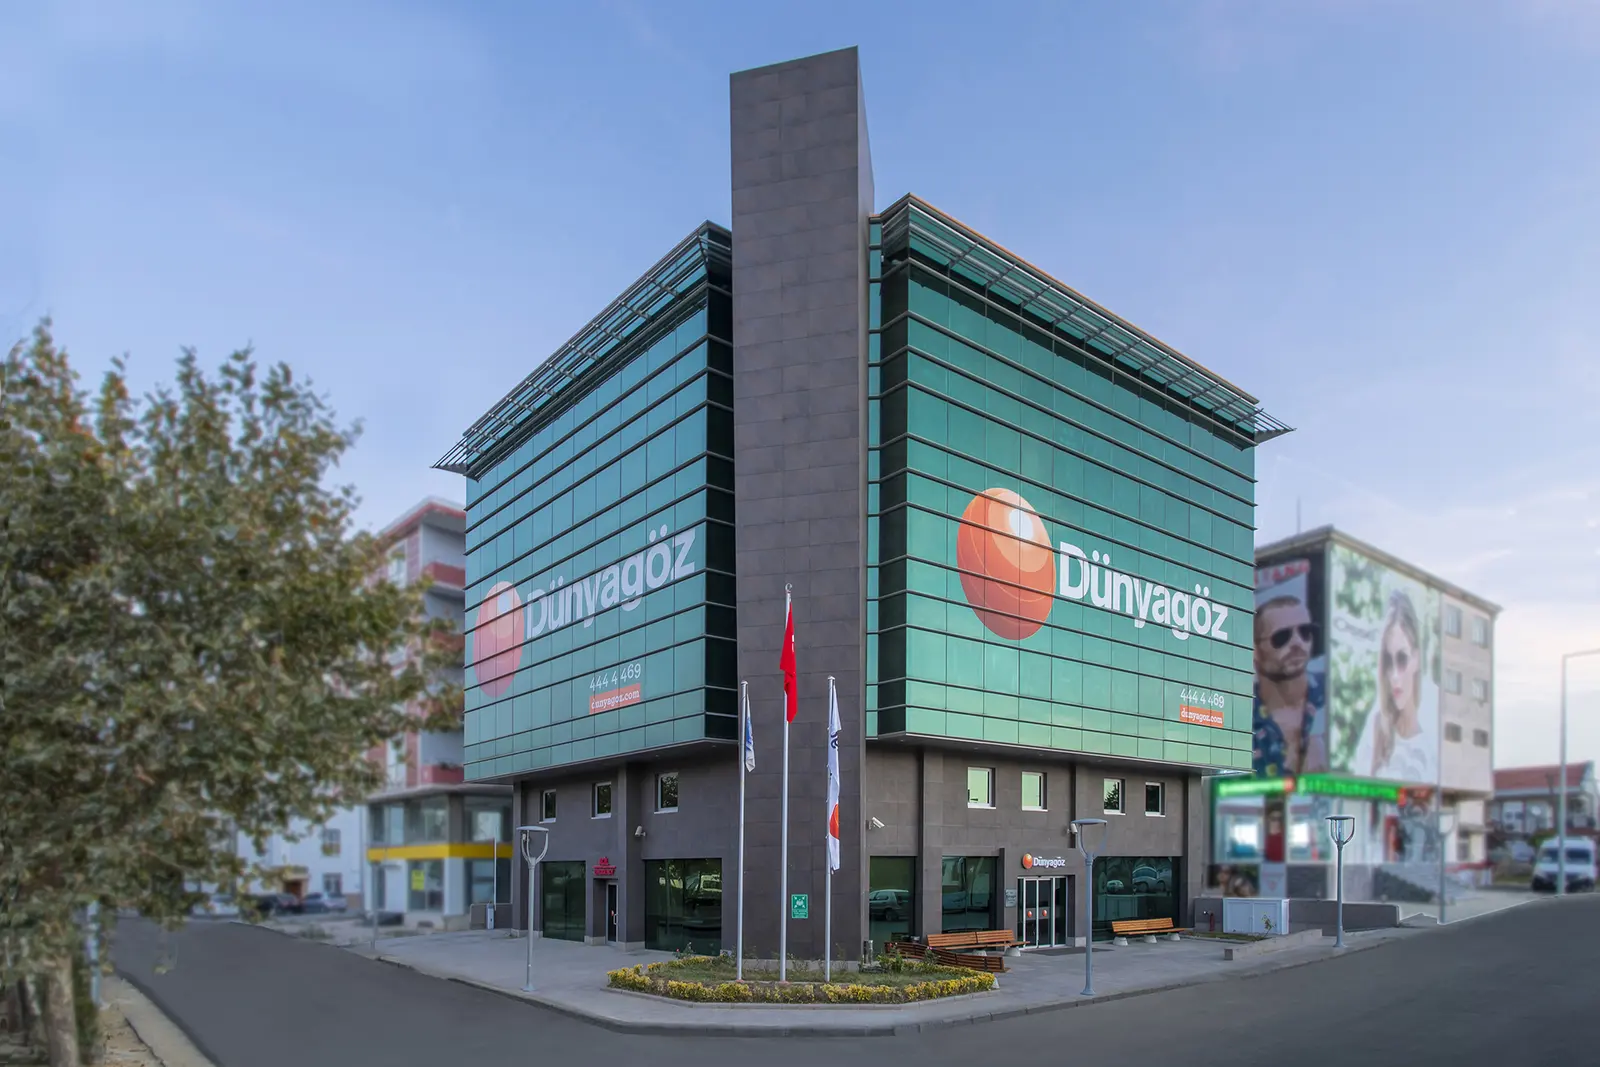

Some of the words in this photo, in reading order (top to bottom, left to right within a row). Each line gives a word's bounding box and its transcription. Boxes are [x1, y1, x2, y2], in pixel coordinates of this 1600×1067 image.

[526, 524, 696, 640] Dünyagöz
[1059, 541, 1229, 641] Dünyagöz
[590, 673, 609, 692] 444
[611, 670, 618, 685] 4
[620, 663, 641, 683] 469
[1180, 689, 1198, 704] 444
[1200, 692, 1207, 705] 4
[1208, 693, 1225, 709] 469
